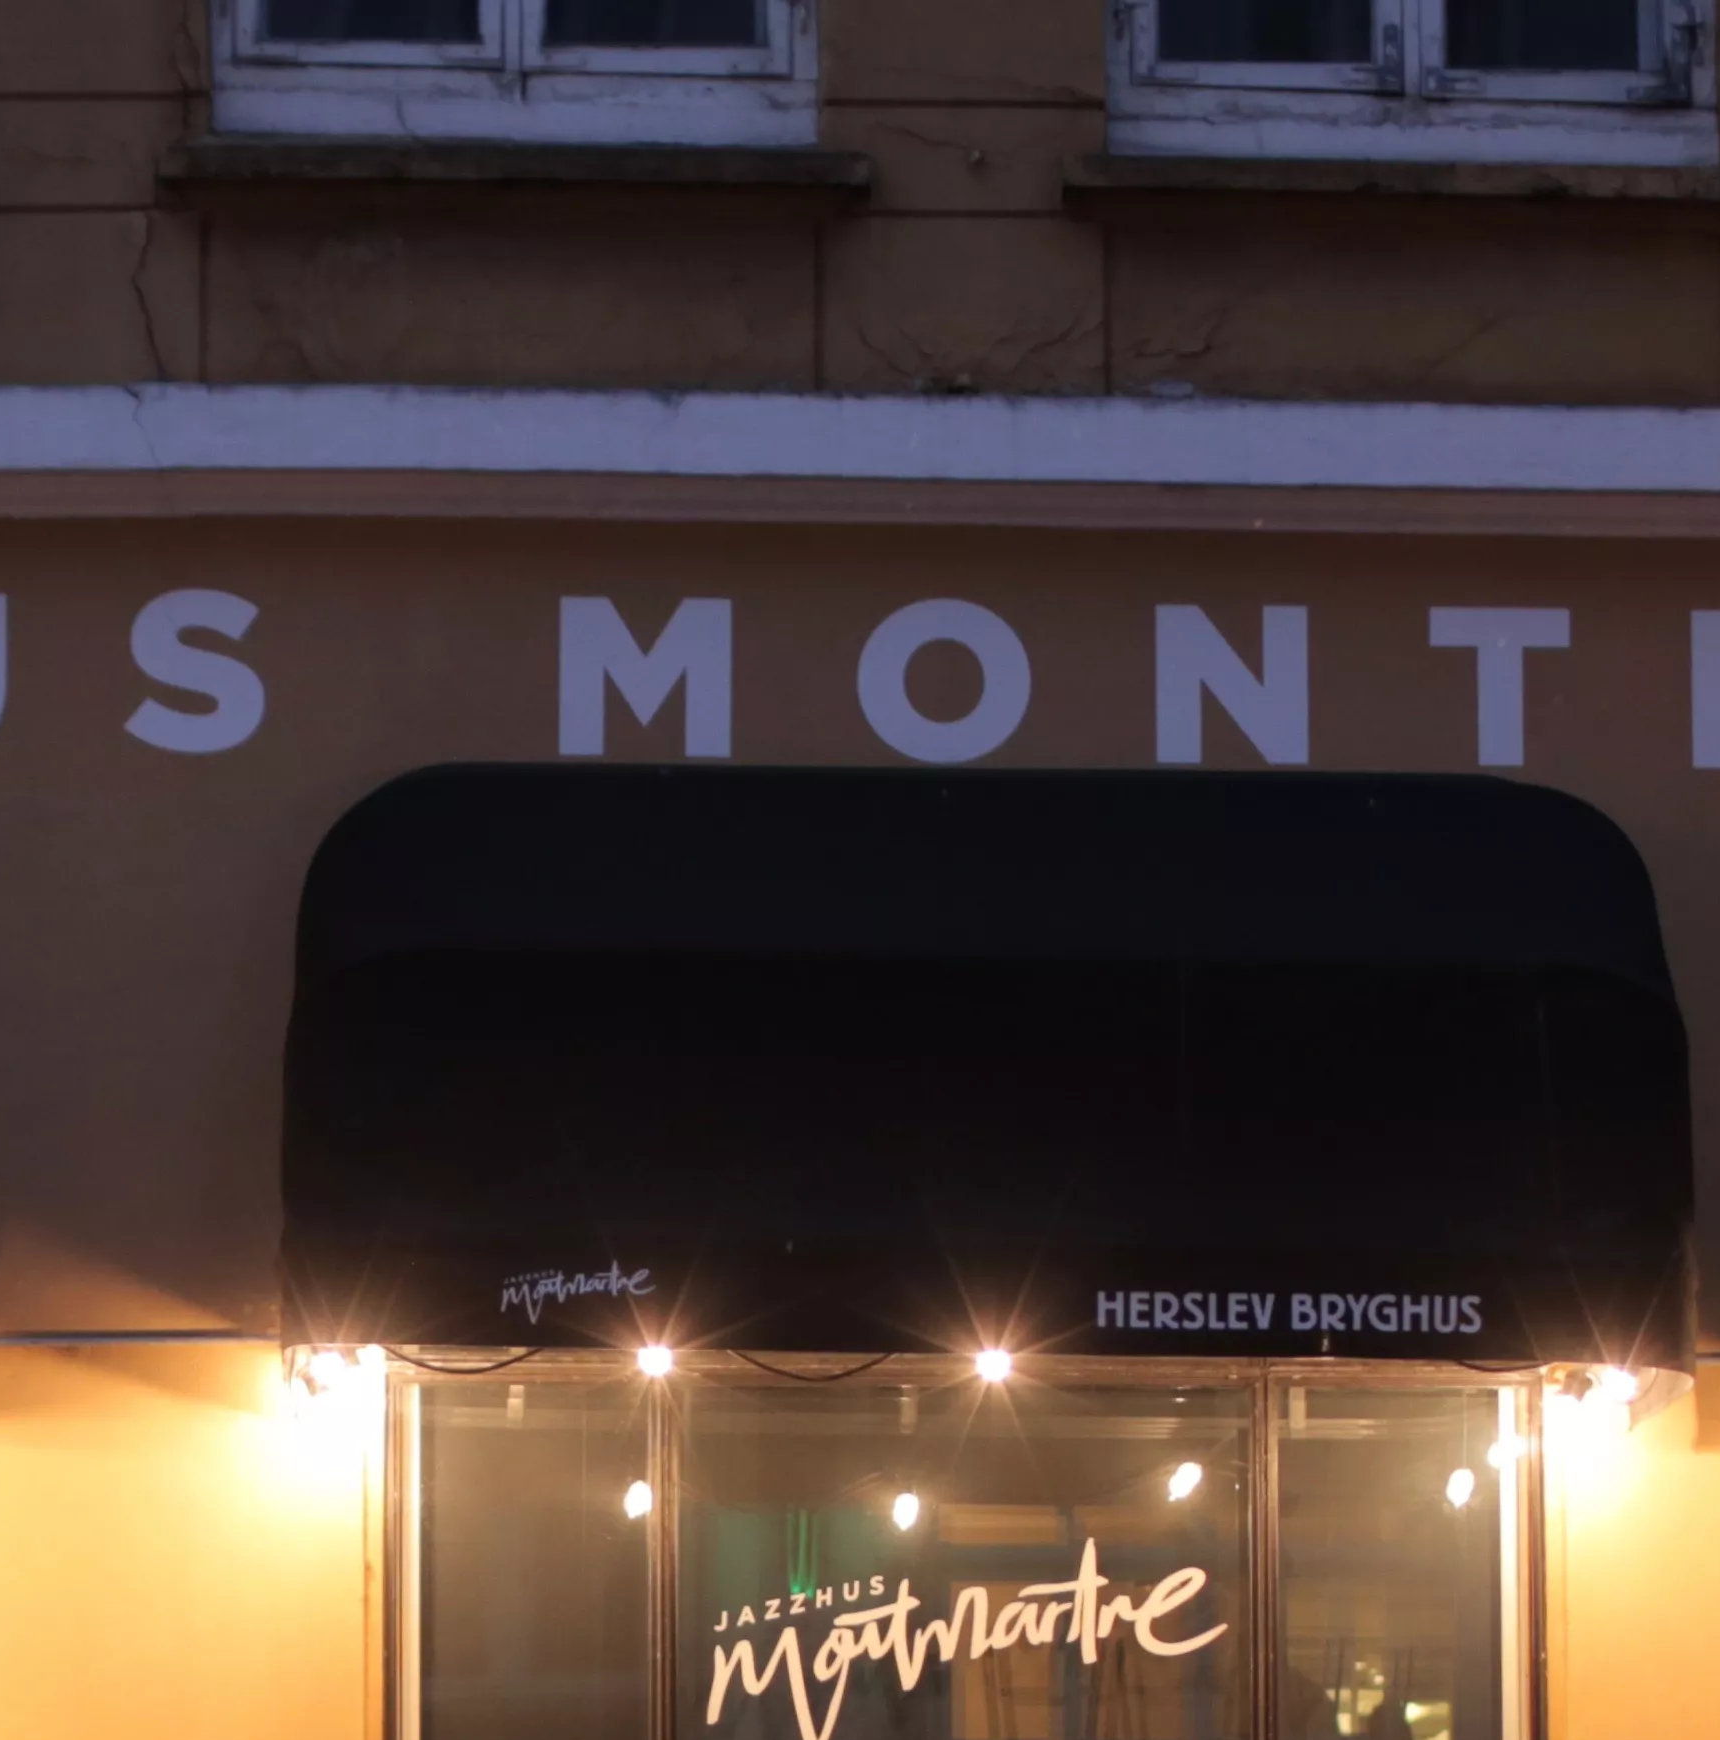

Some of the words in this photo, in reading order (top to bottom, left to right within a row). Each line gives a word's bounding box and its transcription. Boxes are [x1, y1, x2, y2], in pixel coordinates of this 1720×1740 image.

[1097, 1289, 1275, 1332] HERSLEV
[1288, 1291, 1482, 1337] BRYGHUS
[713, 1574, 887, 1630] JAZZHUS
